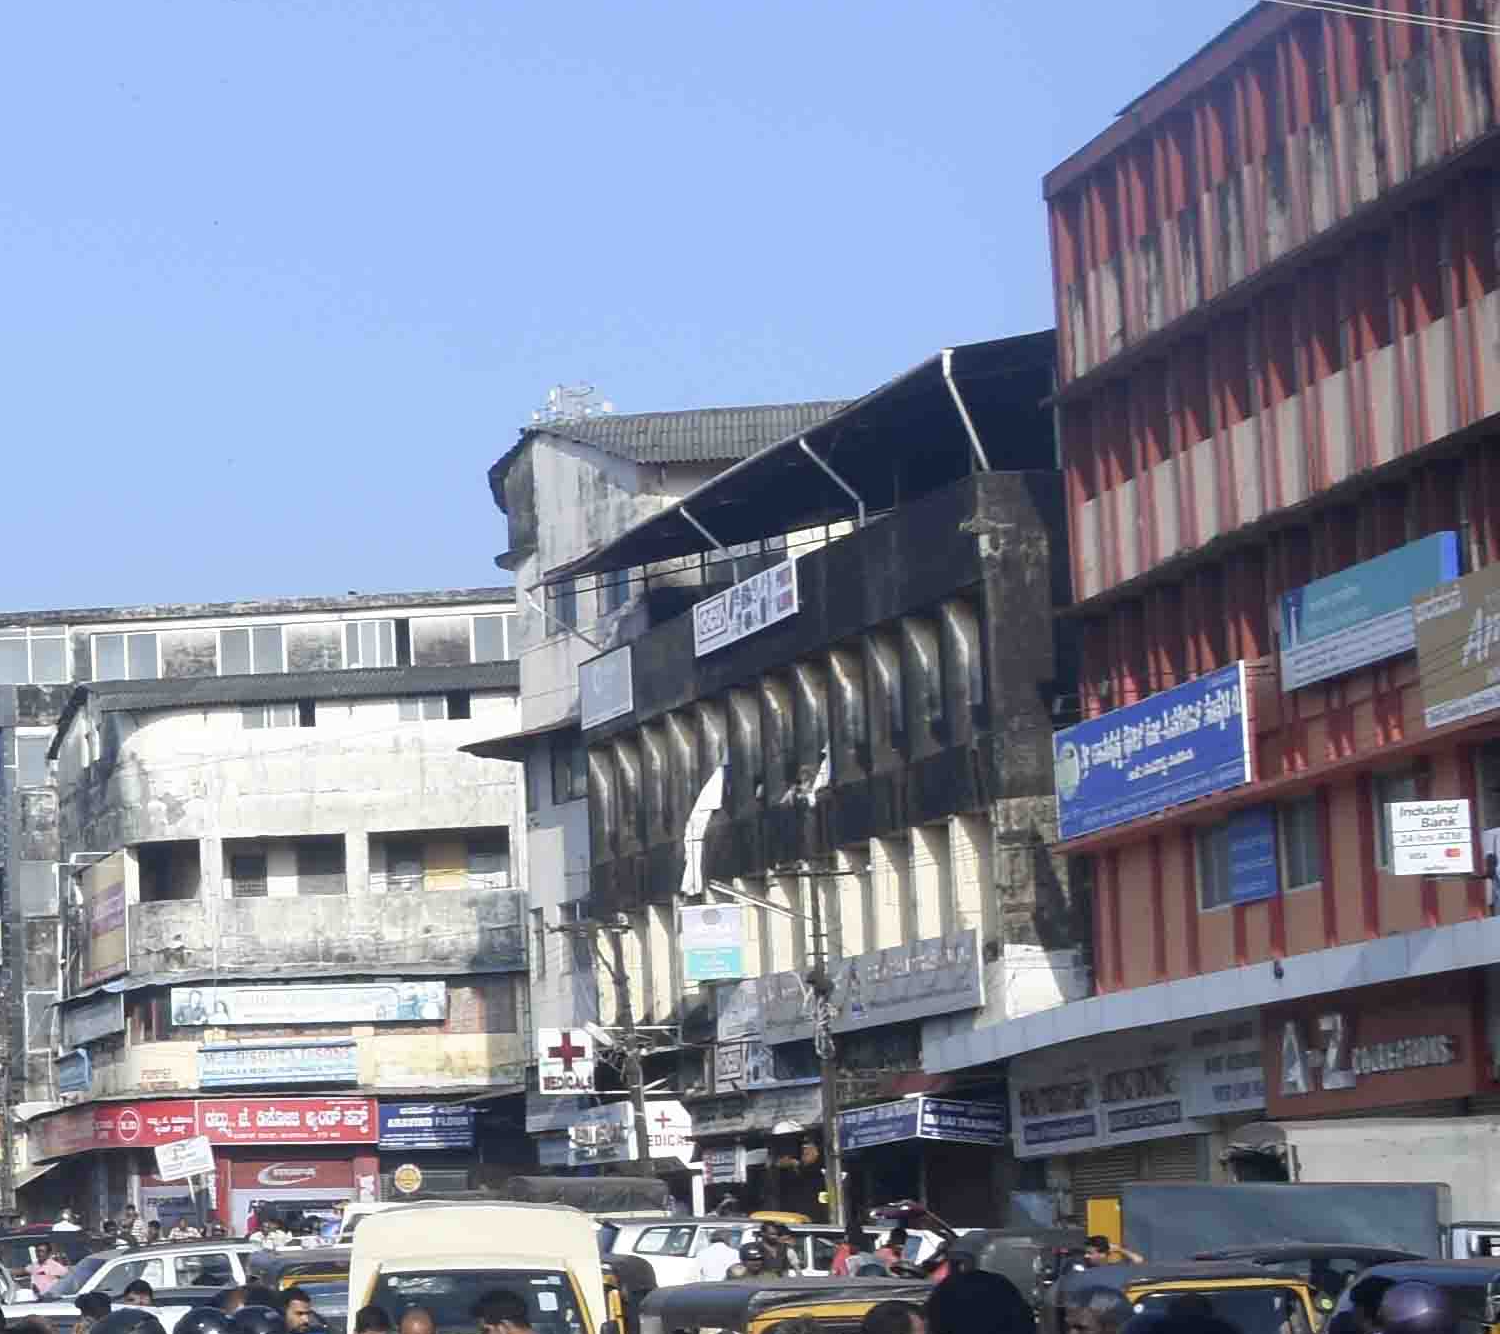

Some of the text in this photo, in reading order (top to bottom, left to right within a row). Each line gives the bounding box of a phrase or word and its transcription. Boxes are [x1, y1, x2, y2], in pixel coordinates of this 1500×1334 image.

[1399, 803, 1460, 819] IndusInd
[1421, 817, 1460, 829] Bank
[542, 1075, 594, 1091] MEDICALS
